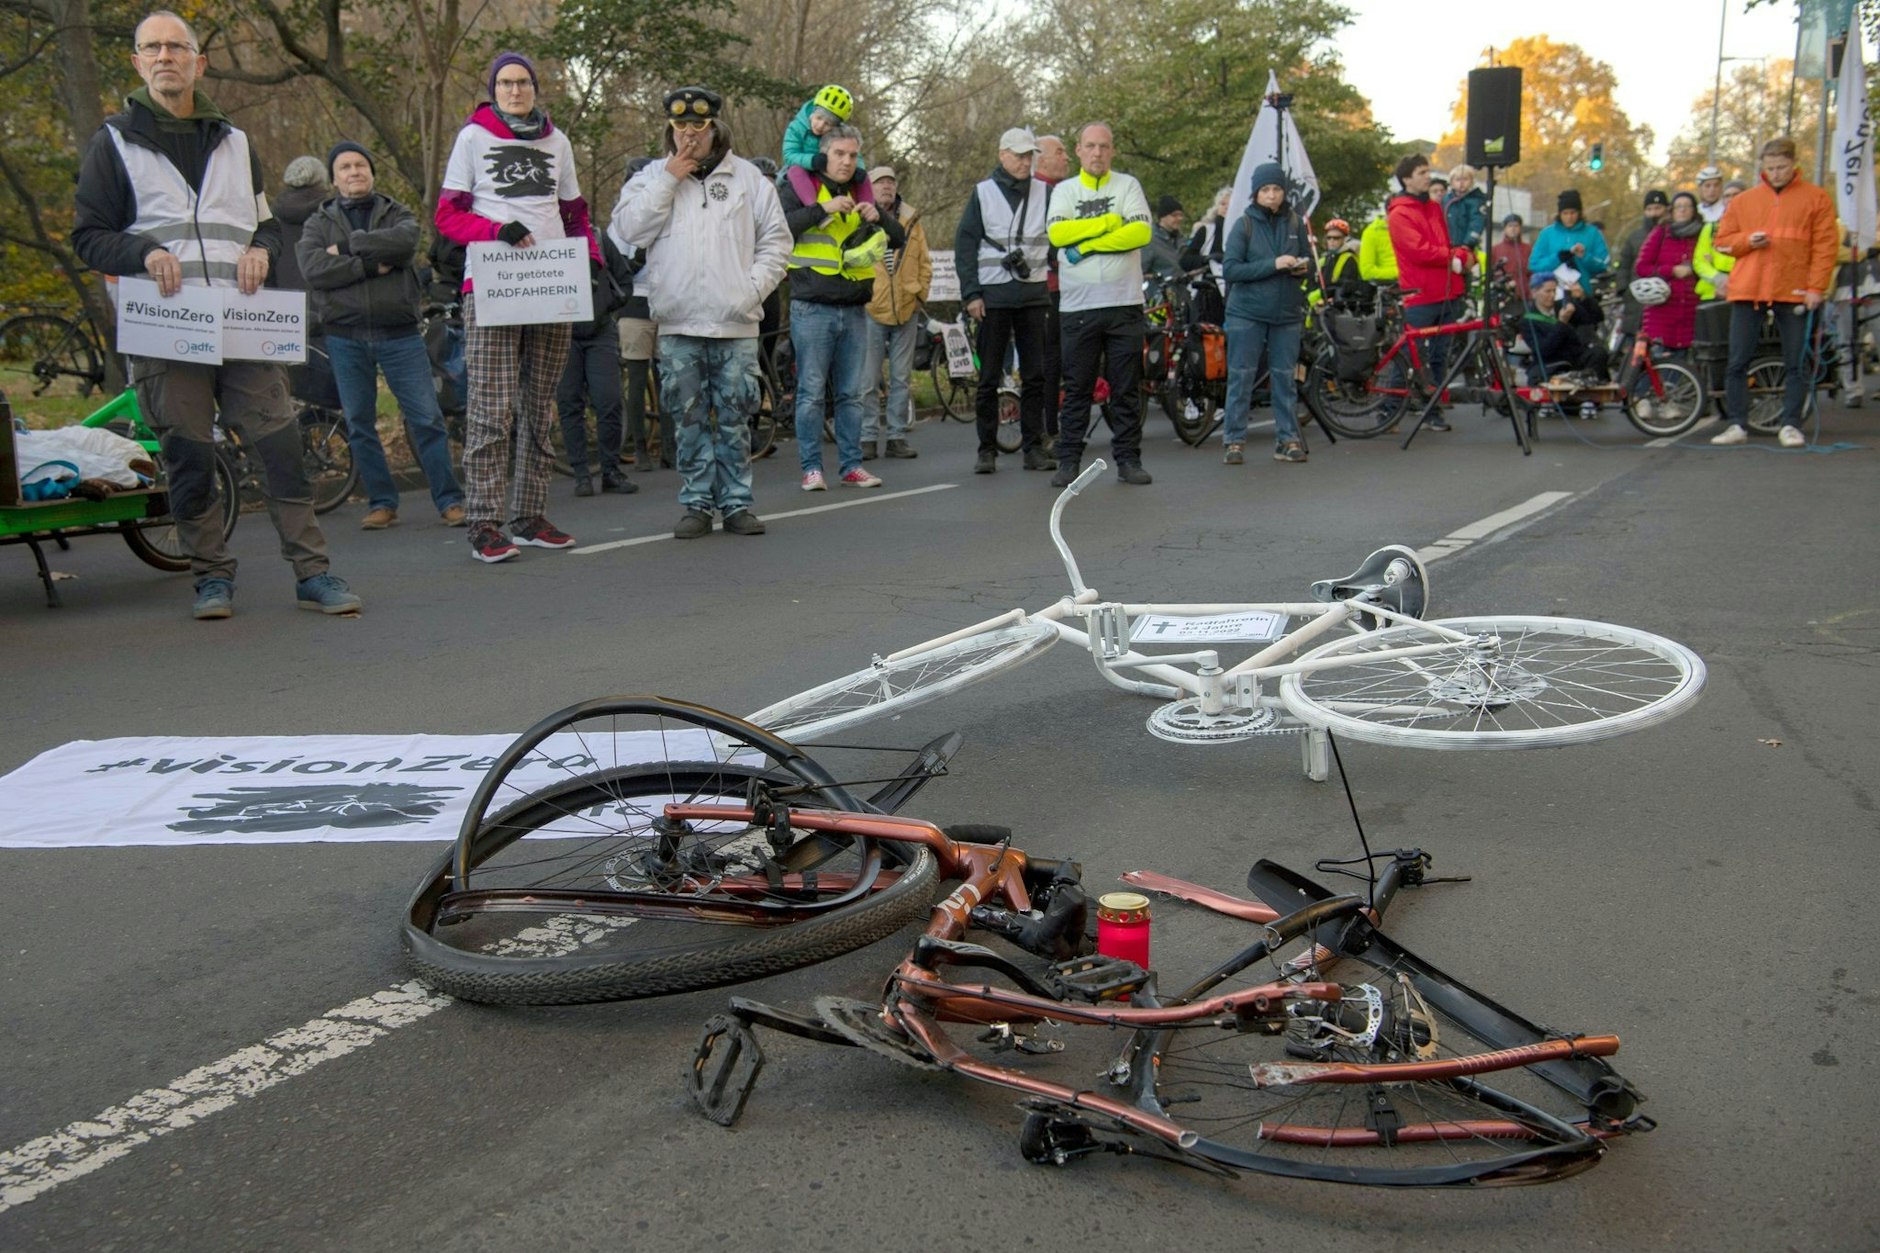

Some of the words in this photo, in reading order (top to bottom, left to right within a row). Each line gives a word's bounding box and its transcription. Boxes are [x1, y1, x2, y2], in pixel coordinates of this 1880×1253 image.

[482, 248, 577, 263] MAHNWACHE
[497, 271, 514, 280] für
[516, 268, 565, 282] getötete
[487, 285, 578, 299] RADFAHRERIN
[125, 300, 215, 324] #VisionZero
[190, 341, 215, 353] adfc
[277, 341, 301, 353] adfc
